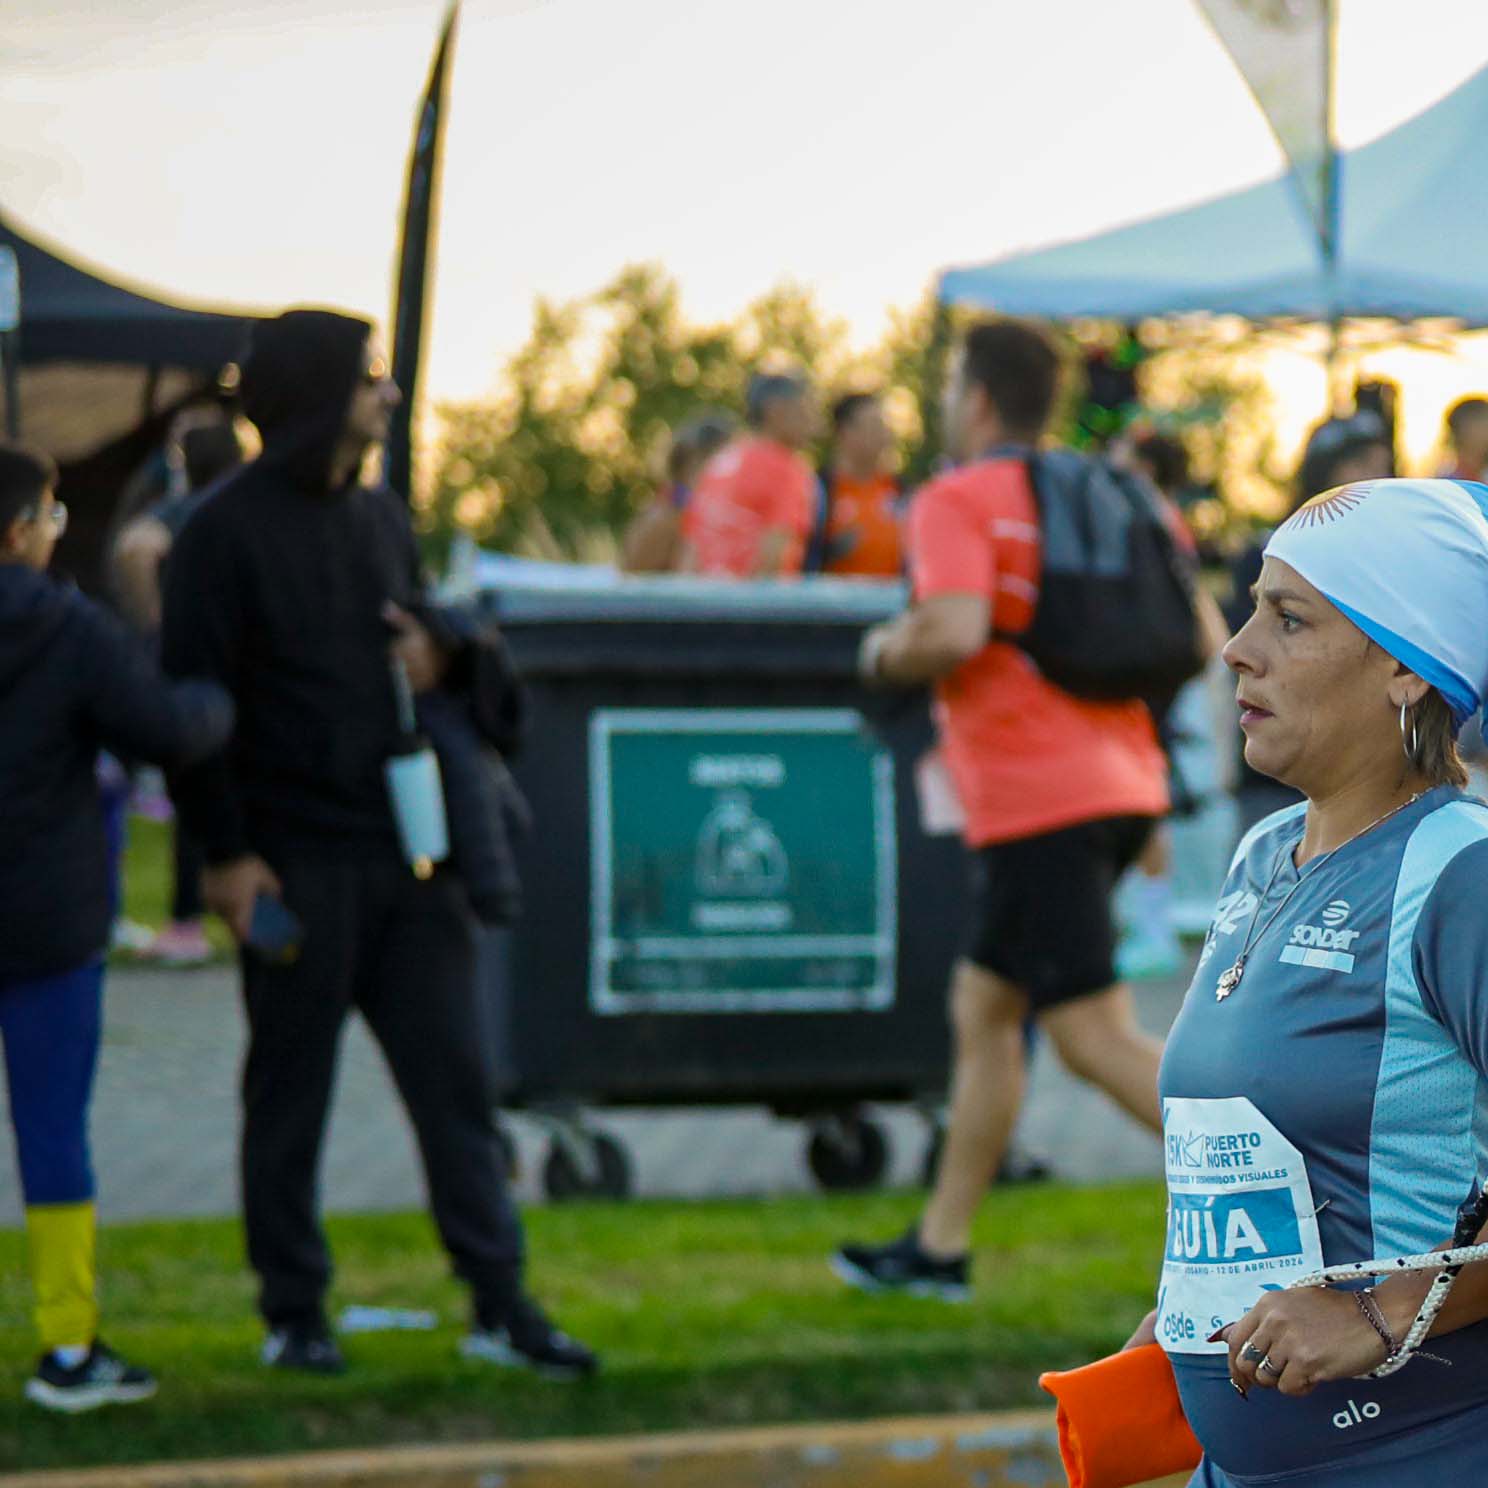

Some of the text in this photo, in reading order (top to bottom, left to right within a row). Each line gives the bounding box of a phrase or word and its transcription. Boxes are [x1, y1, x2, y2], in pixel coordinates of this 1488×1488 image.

[1205, 1131, 1262, 1151] PUERTO
[1206, 1150, 1254, 1168] NORTE
[1239, 1168, 1289, 1182] VISUALES
[1228, 1265, 1241, 1275] DE
[1244, 1262, 1275, 1273] ABRIL
[1163, 1311, 1196, 1342] osde
[1332, 1399, 1381, 1429] alo
